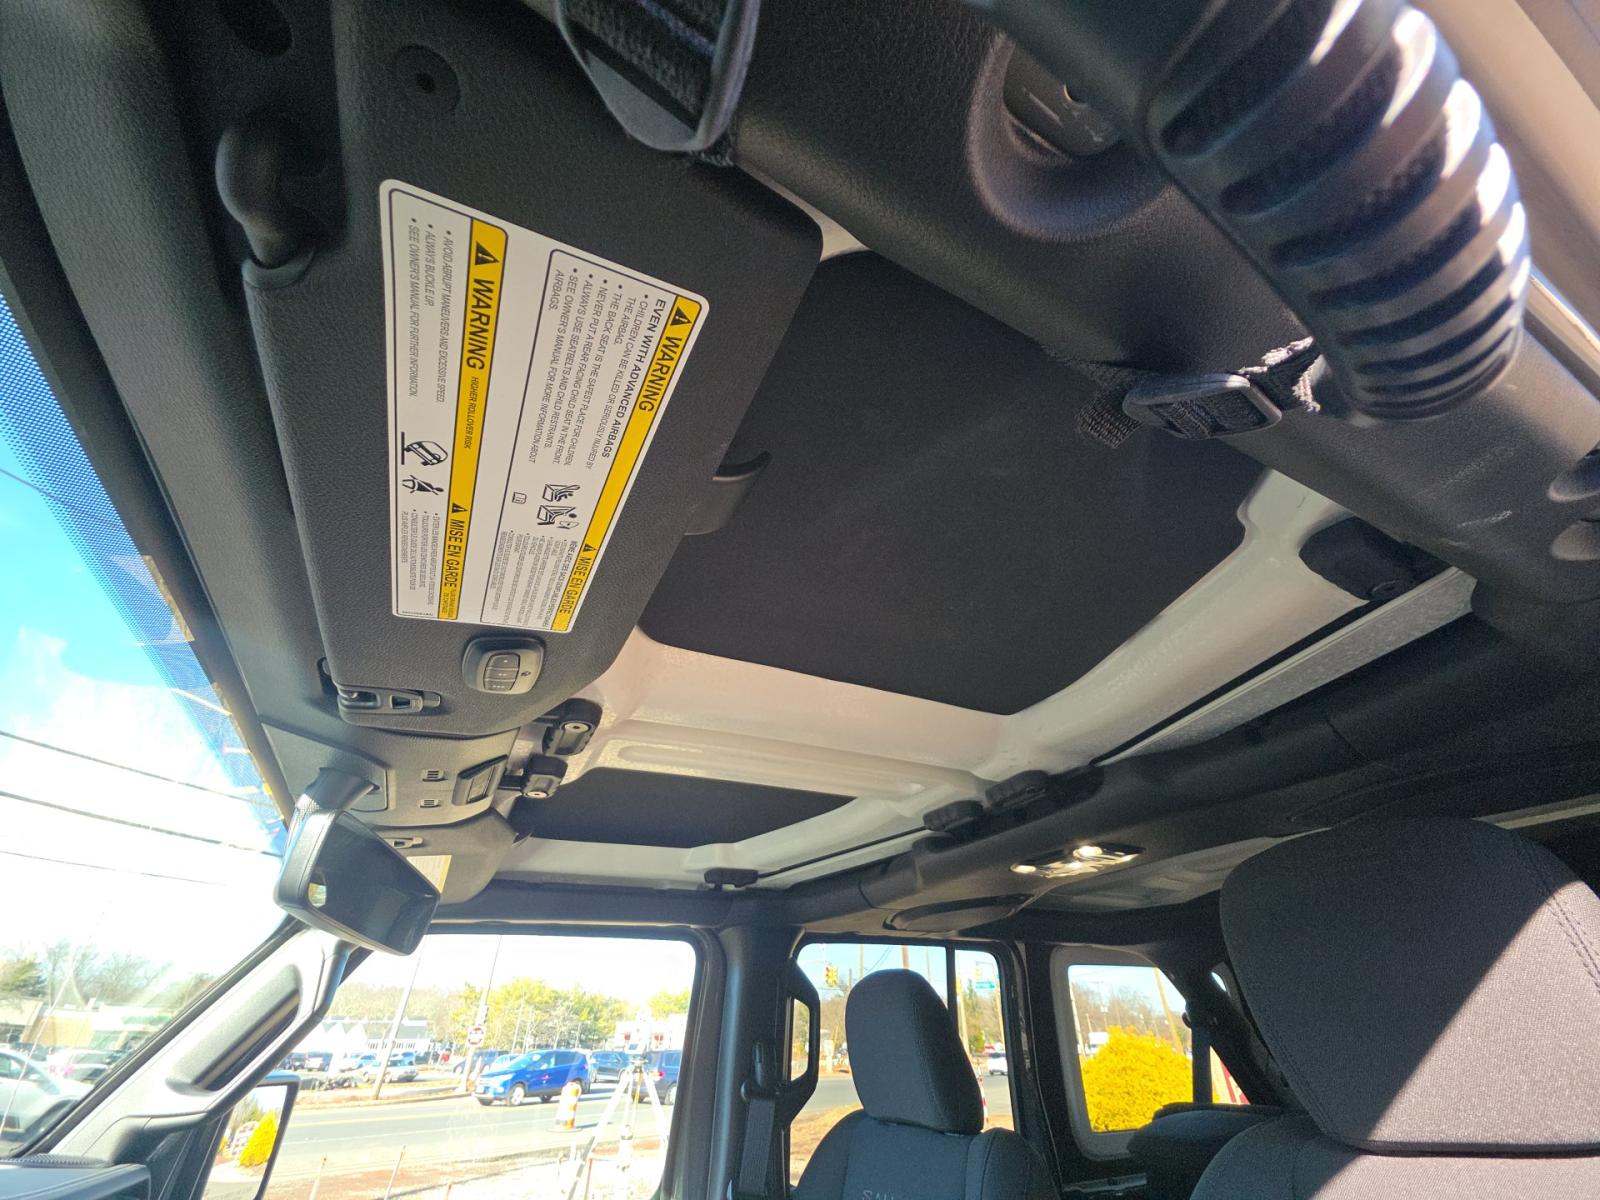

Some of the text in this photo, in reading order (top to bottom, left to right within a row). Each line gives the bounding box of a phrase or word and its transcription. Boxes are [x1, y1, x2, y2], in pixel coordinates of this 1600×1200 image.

[409, 224, 418, 243] SEE
[425, 230, 435, 264] ALWAYS
[443, 236, 453, 262] AVOID
[408, 242, 418, 280] OWNER'S
[424, 263, 434, 294] BUCKLE
[441, 261, 452, 293] ABRUPT
[409, 279, 418, 310] MANUAL
[576, 279, 592, 315] ALWAYS
[591, 286, 606, 316] NEVER
[609, 291, 621, 310] THE
[623, 296, 635, 314] THE
[409, 310, 417, 326] FOR
[439, 292, 450, 336] MANEUVERS
[466, 275, 494, 370] WARNING
[572, 315, 583, 333] USE
[586, 316, 597, 334] PUT
[603, 310, 616, 333] BACK
[627, 300, 647, 341] CHILDREN
[409, 325, 417, 356] FURTHER
[439, 335, 447, 350] AND
[579, 340, 591, 361] REAR
[596, 333, 609, 353] SEAT
[622, 341, 633, 358] CAN
[437, 349, 446, 383] EXCESSIVE
[562, 333, 579, 375] SEATBELTS
[618, 358, 627, 369] BE
[527, 274, 577, 463] SEE OWNER'S MANUAL FOR MORE INFORMATION ABOUT
[572, 361, 585, 388] FACING
[589, 362, 600, 377] THE
[601, 297, 666, 458] EVEN WITH ADVANCED AIRBAGS
[637, 333, 682, 413] WARNING
[558, 374, 569, 391] AND
[582, 377, 595, 403] SAFEST
[610, 369, 624, 393] KILLED
[553, 390, 564, 410] CHILD
[567, 388, 578, 408] CHILD
[606, 393, 616, 404] OR
[463, 376, 478, 449] HIGHER ROLLOVER RISK
[562, 408, 573, 425] SEAT
[576, 403, 587, 424] PLACE
[595, 404, 612, 437] SERIOUSLY
[557, 432, 566, 444] THE
[572, 424, 581, 437] FOR
[448, 518, 464, 542] MISE
[447, 544, 461, 557] EN
[443, 558, 459, 587] GARDE
[559, 556, 591, 613] MISE EN GARDE
